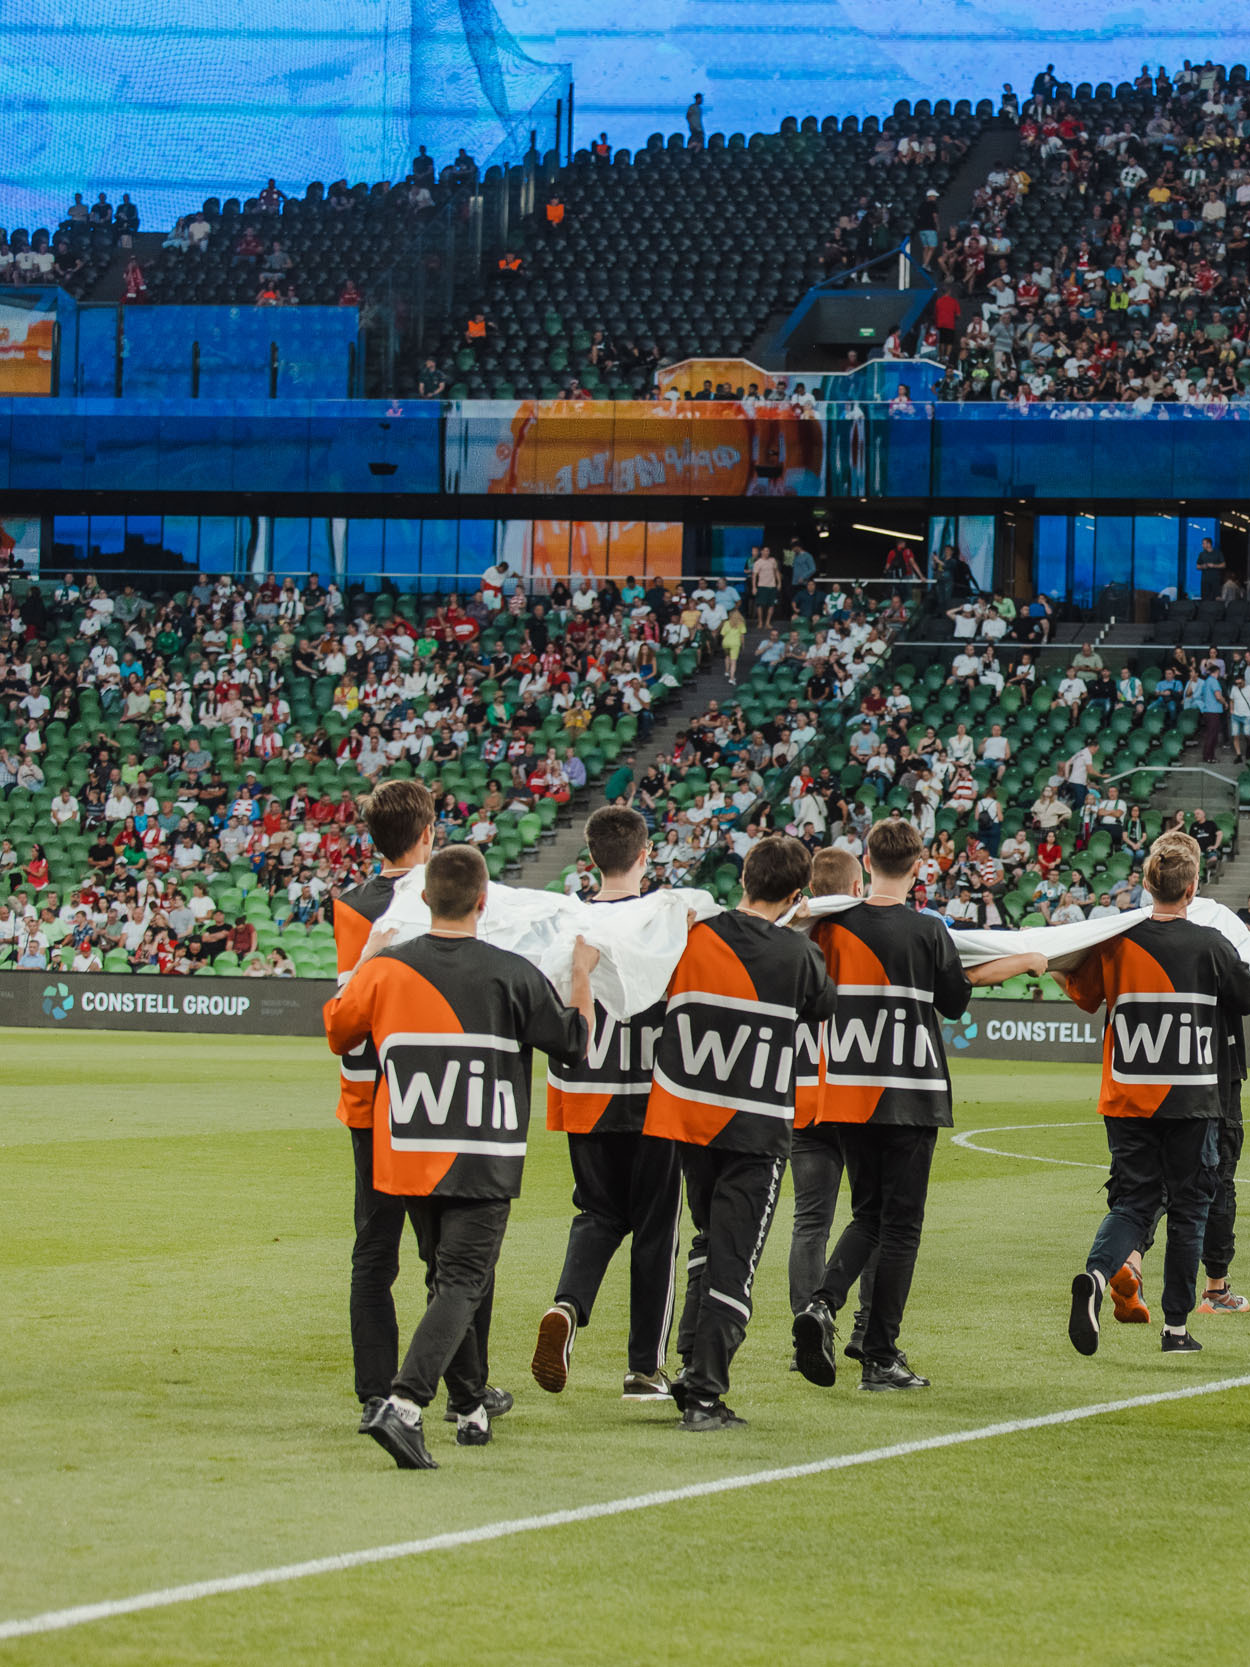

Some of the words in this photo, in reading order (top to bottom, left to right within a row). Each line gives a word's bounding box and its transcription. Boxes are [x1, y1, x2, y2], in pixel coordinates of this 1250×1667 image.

[81, 991, 179, 1014] CONSTELL
[182, 994, 250, 1016] GROUP
[829, 1008, 938, 1068] Win
[986, 1020, 1097, 1043] CONSTELL
[1115, 1013, 1213, 1065] Win
[386, 1059, 518, 1130] Win
